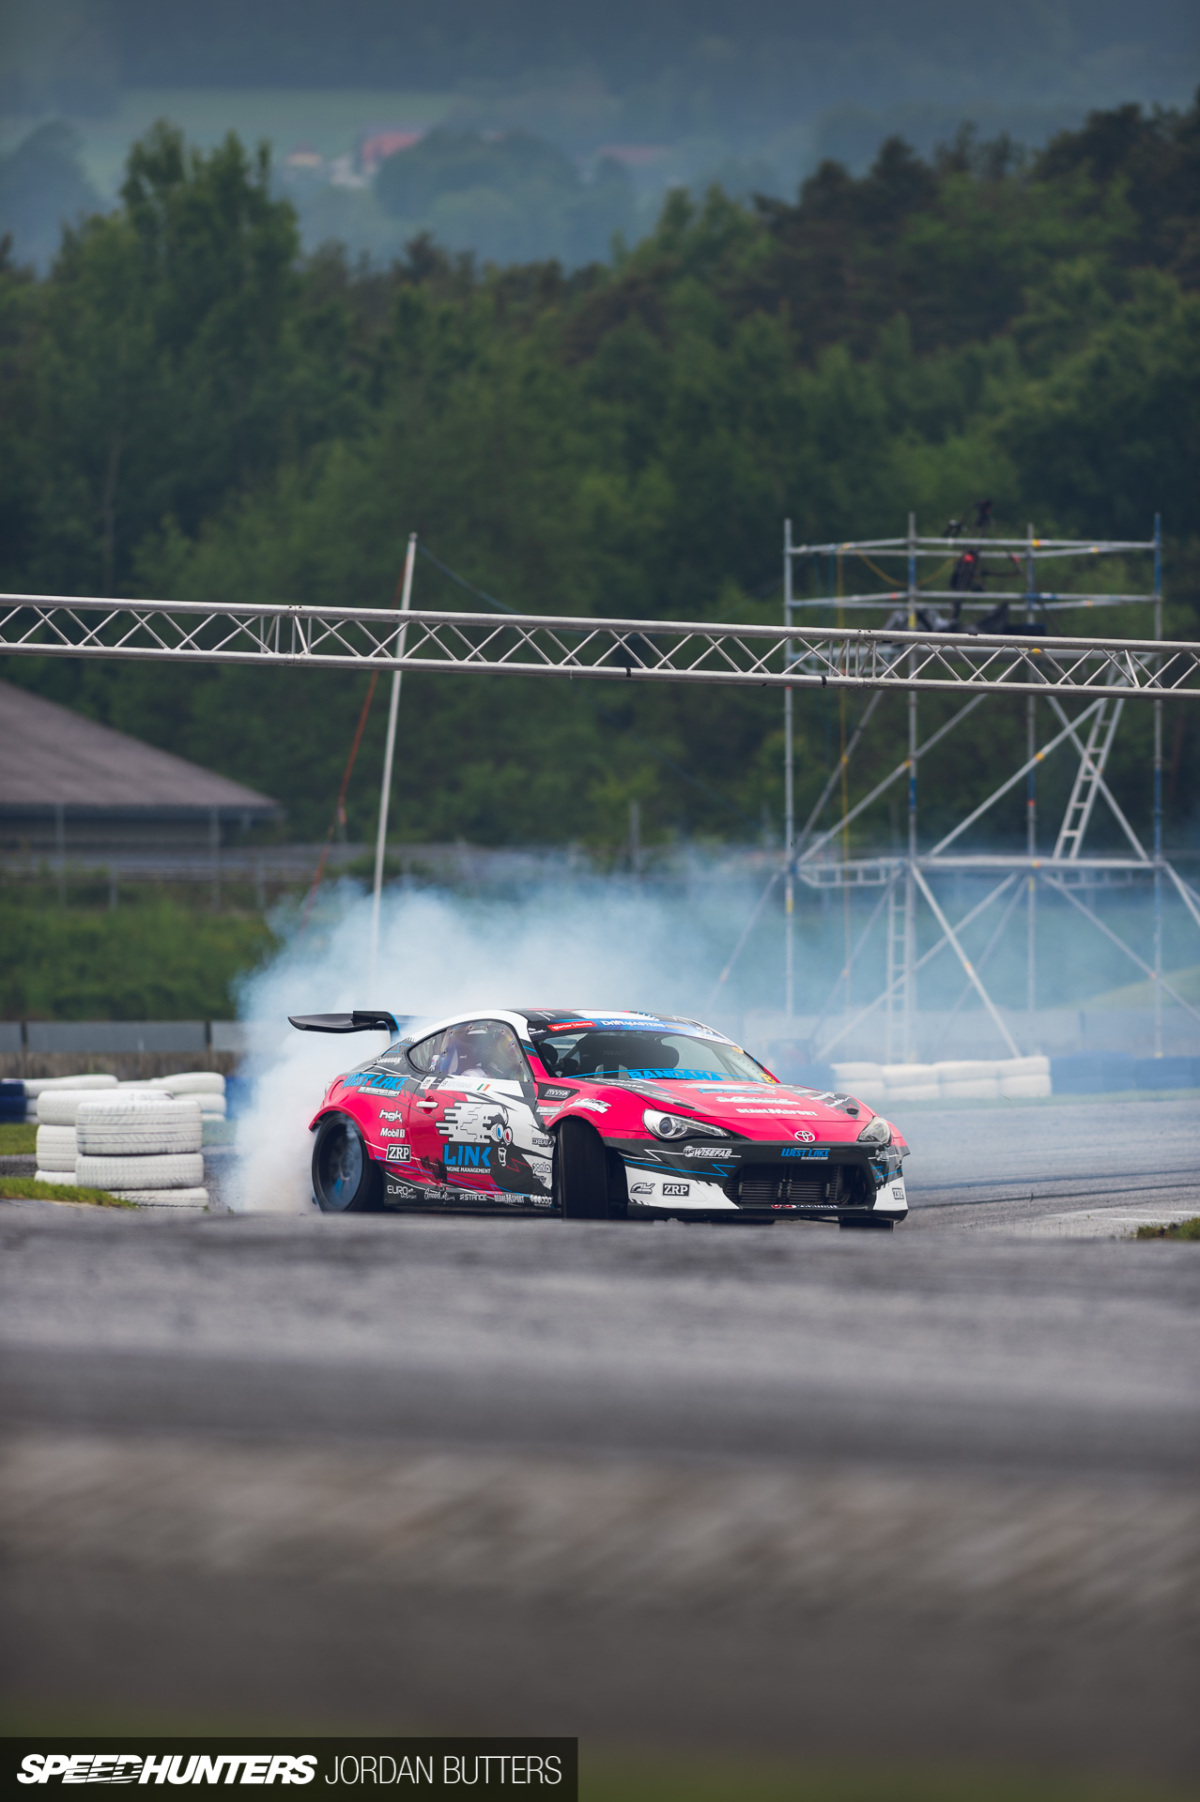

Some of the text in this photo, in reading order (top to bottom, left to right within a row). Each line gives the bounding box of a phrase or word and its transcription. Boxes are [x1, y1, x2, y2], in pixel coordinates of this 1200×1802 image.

[370, 1074, 409, 1091] LAKE
[388, 1146, 410, 1160] ZRP
[443, 1144, 492, 1167] LINK
[808, 1148, 830, 1157] LAKE
[387, 1185, 408, 1195] EURO
[664, 1184, 688, 1196] ZRP
